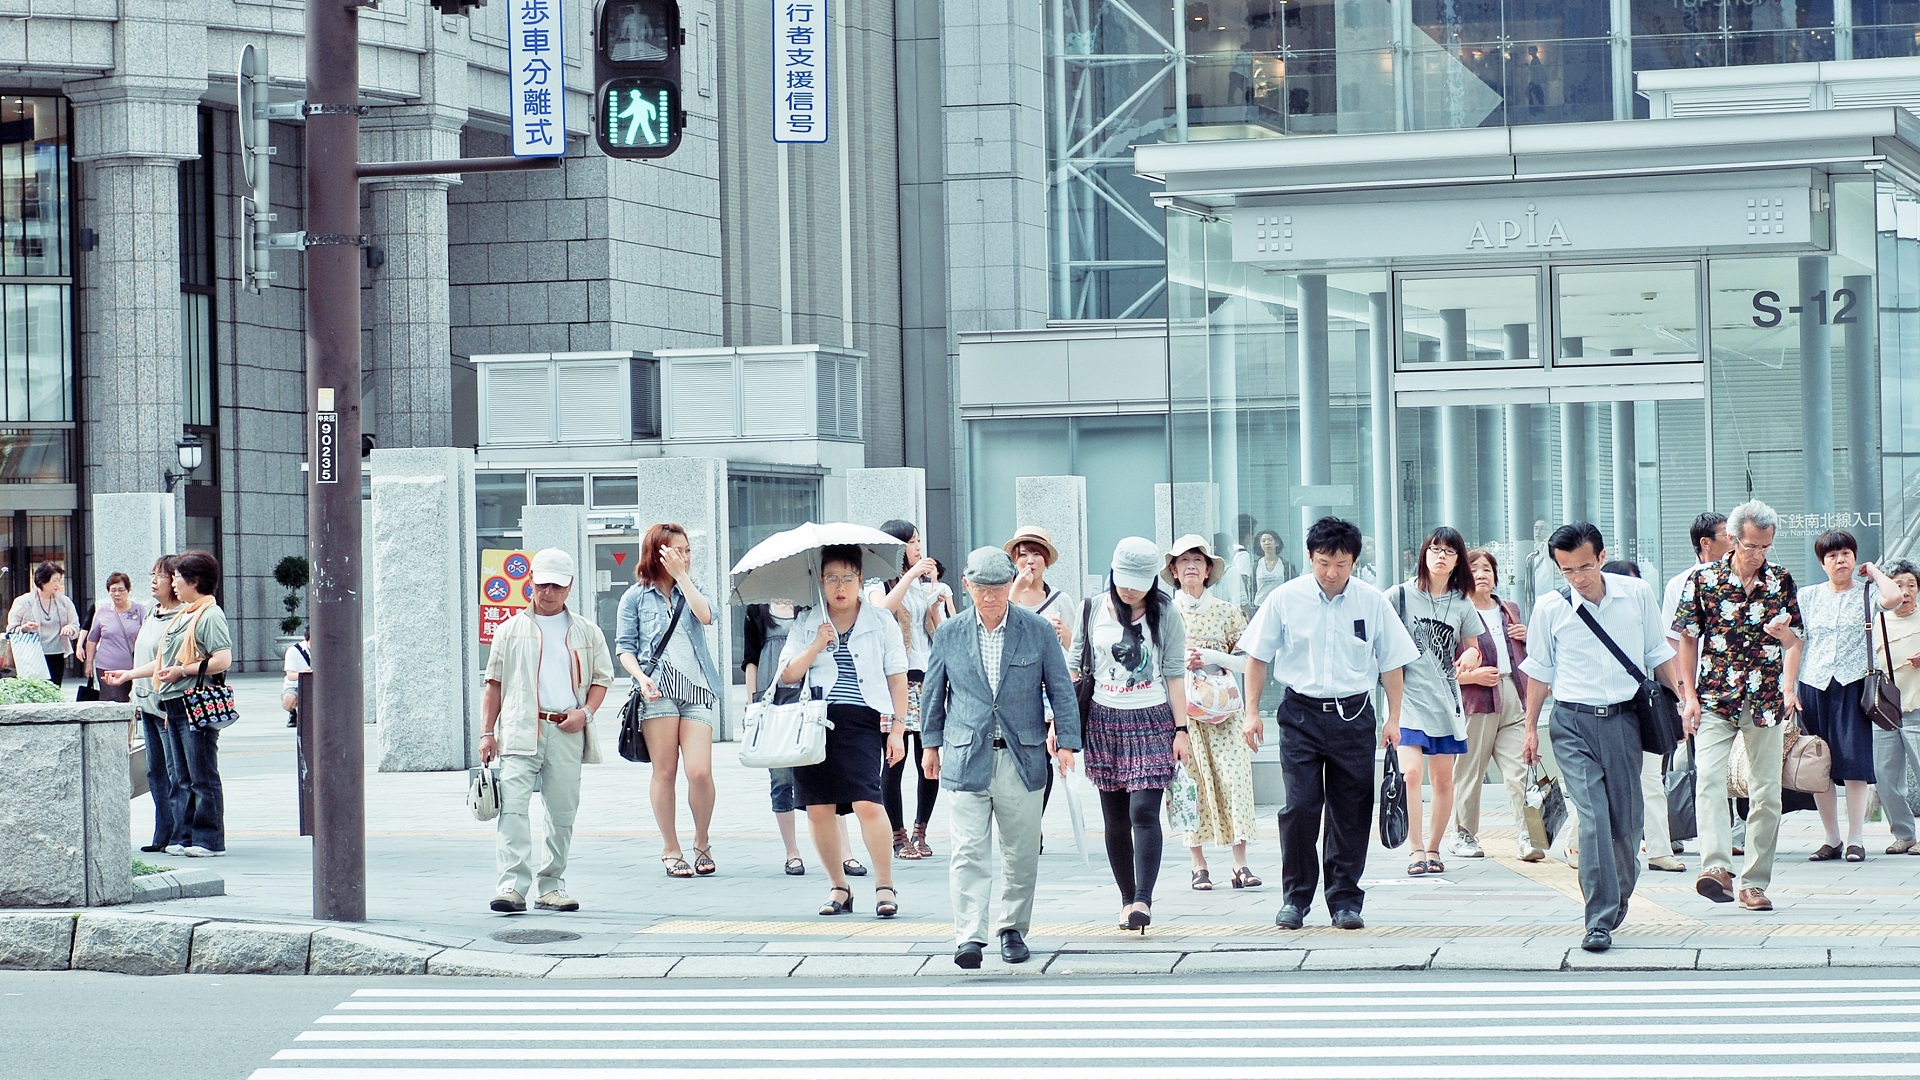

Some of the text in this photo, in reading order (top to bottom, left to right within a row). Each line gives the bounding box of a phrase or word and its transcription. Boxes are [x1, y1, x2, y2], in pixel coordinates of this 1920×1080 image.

[521, 0, 553, 146] 歩車分離式
[785, 3, 815, 133] 行者支援信号
[1752, 288, 1858, 327] S-12
[321, 423, 332, 480] 90235
[1776, 512, 1882, 529] 下鉄南北線入口
